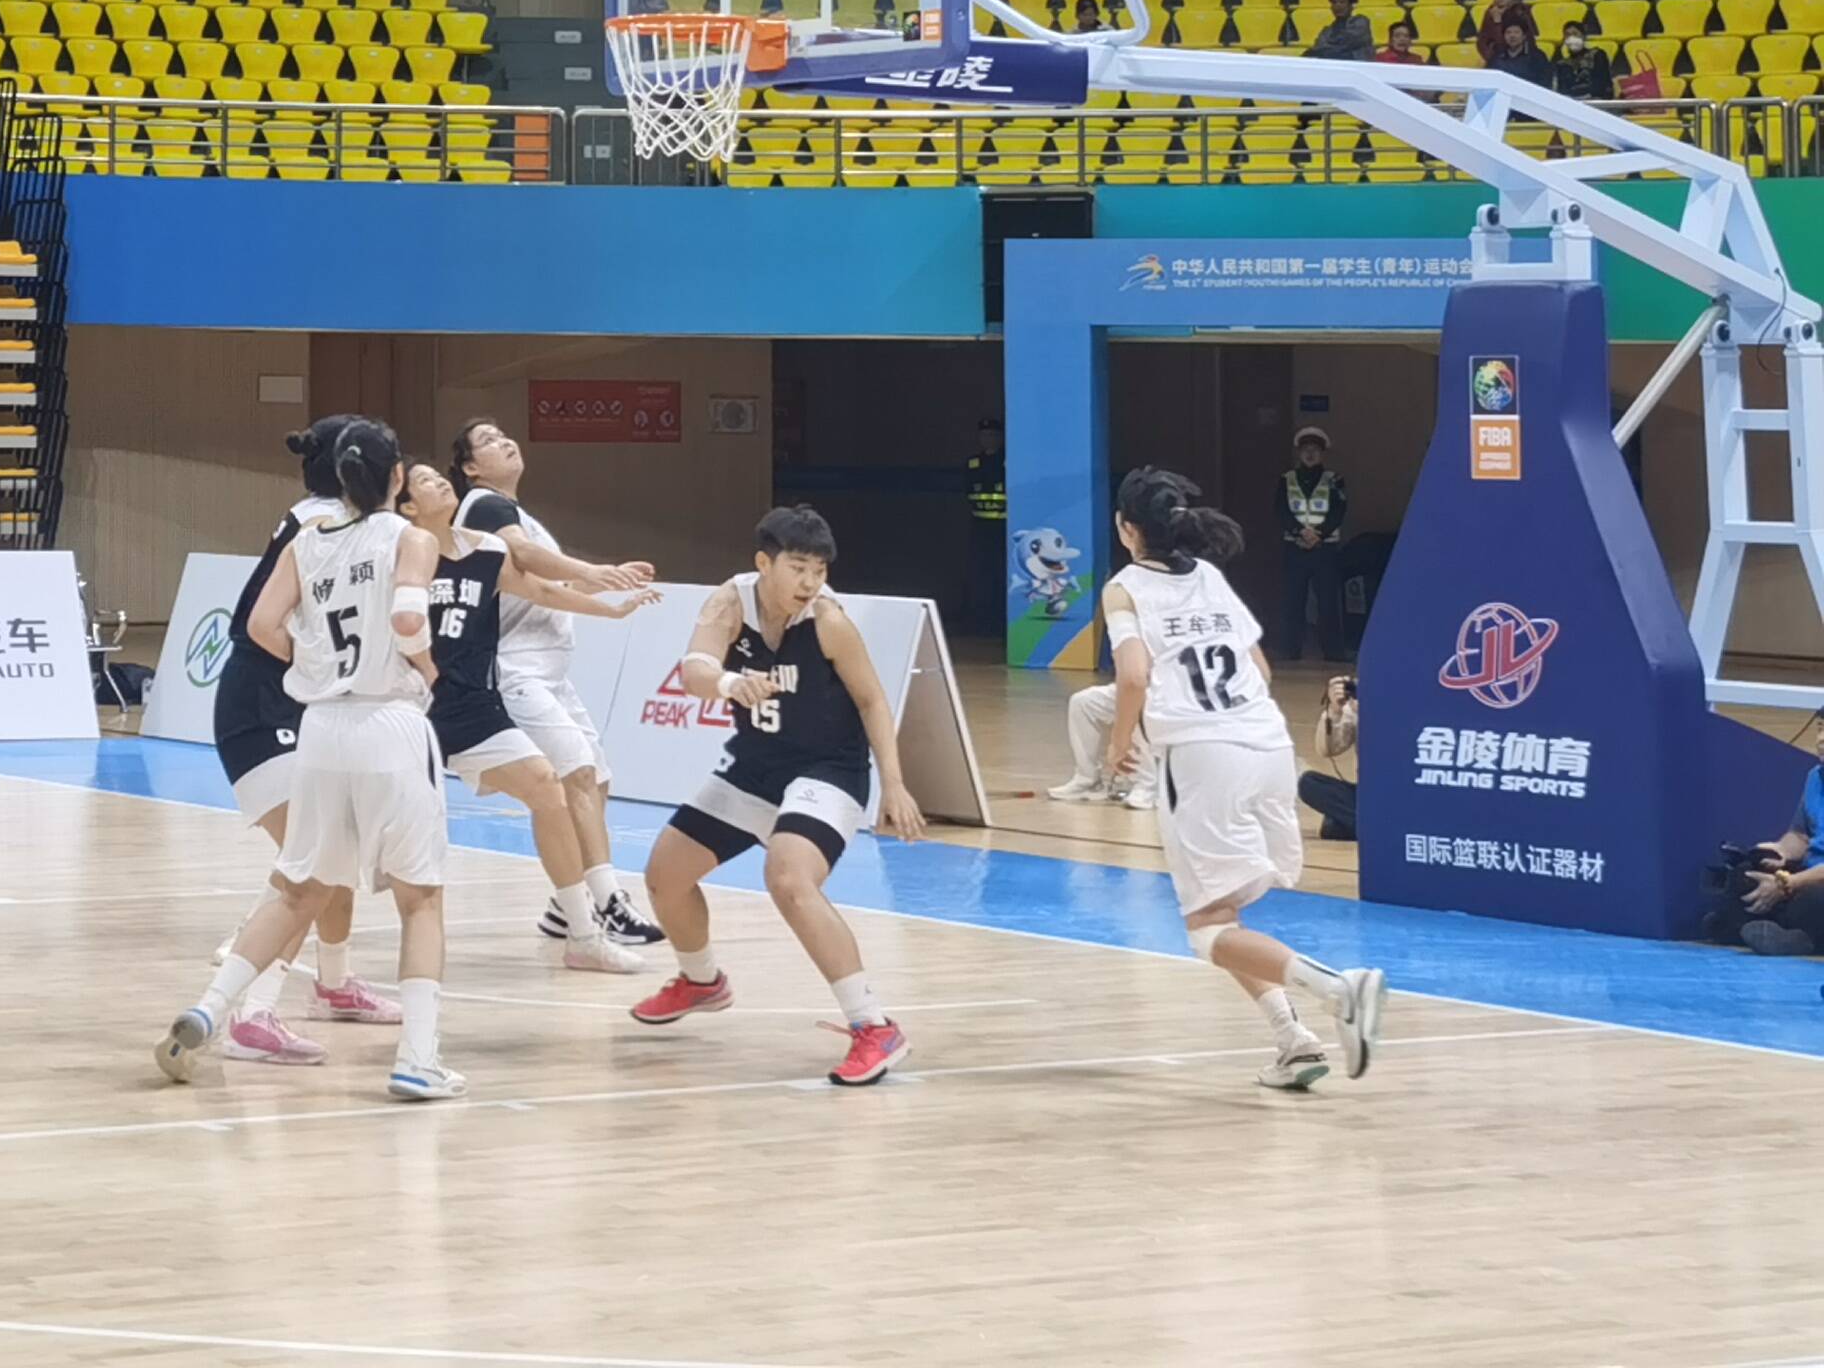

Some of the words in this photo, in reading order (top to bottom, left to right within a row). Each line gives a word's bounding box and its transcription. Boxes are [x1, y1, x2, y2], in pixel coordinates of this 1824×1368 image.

[1478, 426, 1512, 447] FIBA
[327, 606, 362, 679] 5
[438, 608, 467, 638] 16
[1178, 644, 1249, 712] 12
[641, 699, 695, 729] PEAK
[1414, 726, 1591, 778] 金陵体育
[1414, 768, 1494, 790] JINLING
[1500, 774, 1587, 798] SPORTS
[1405, 833, 1605, 884] 国际篮联认证器材
